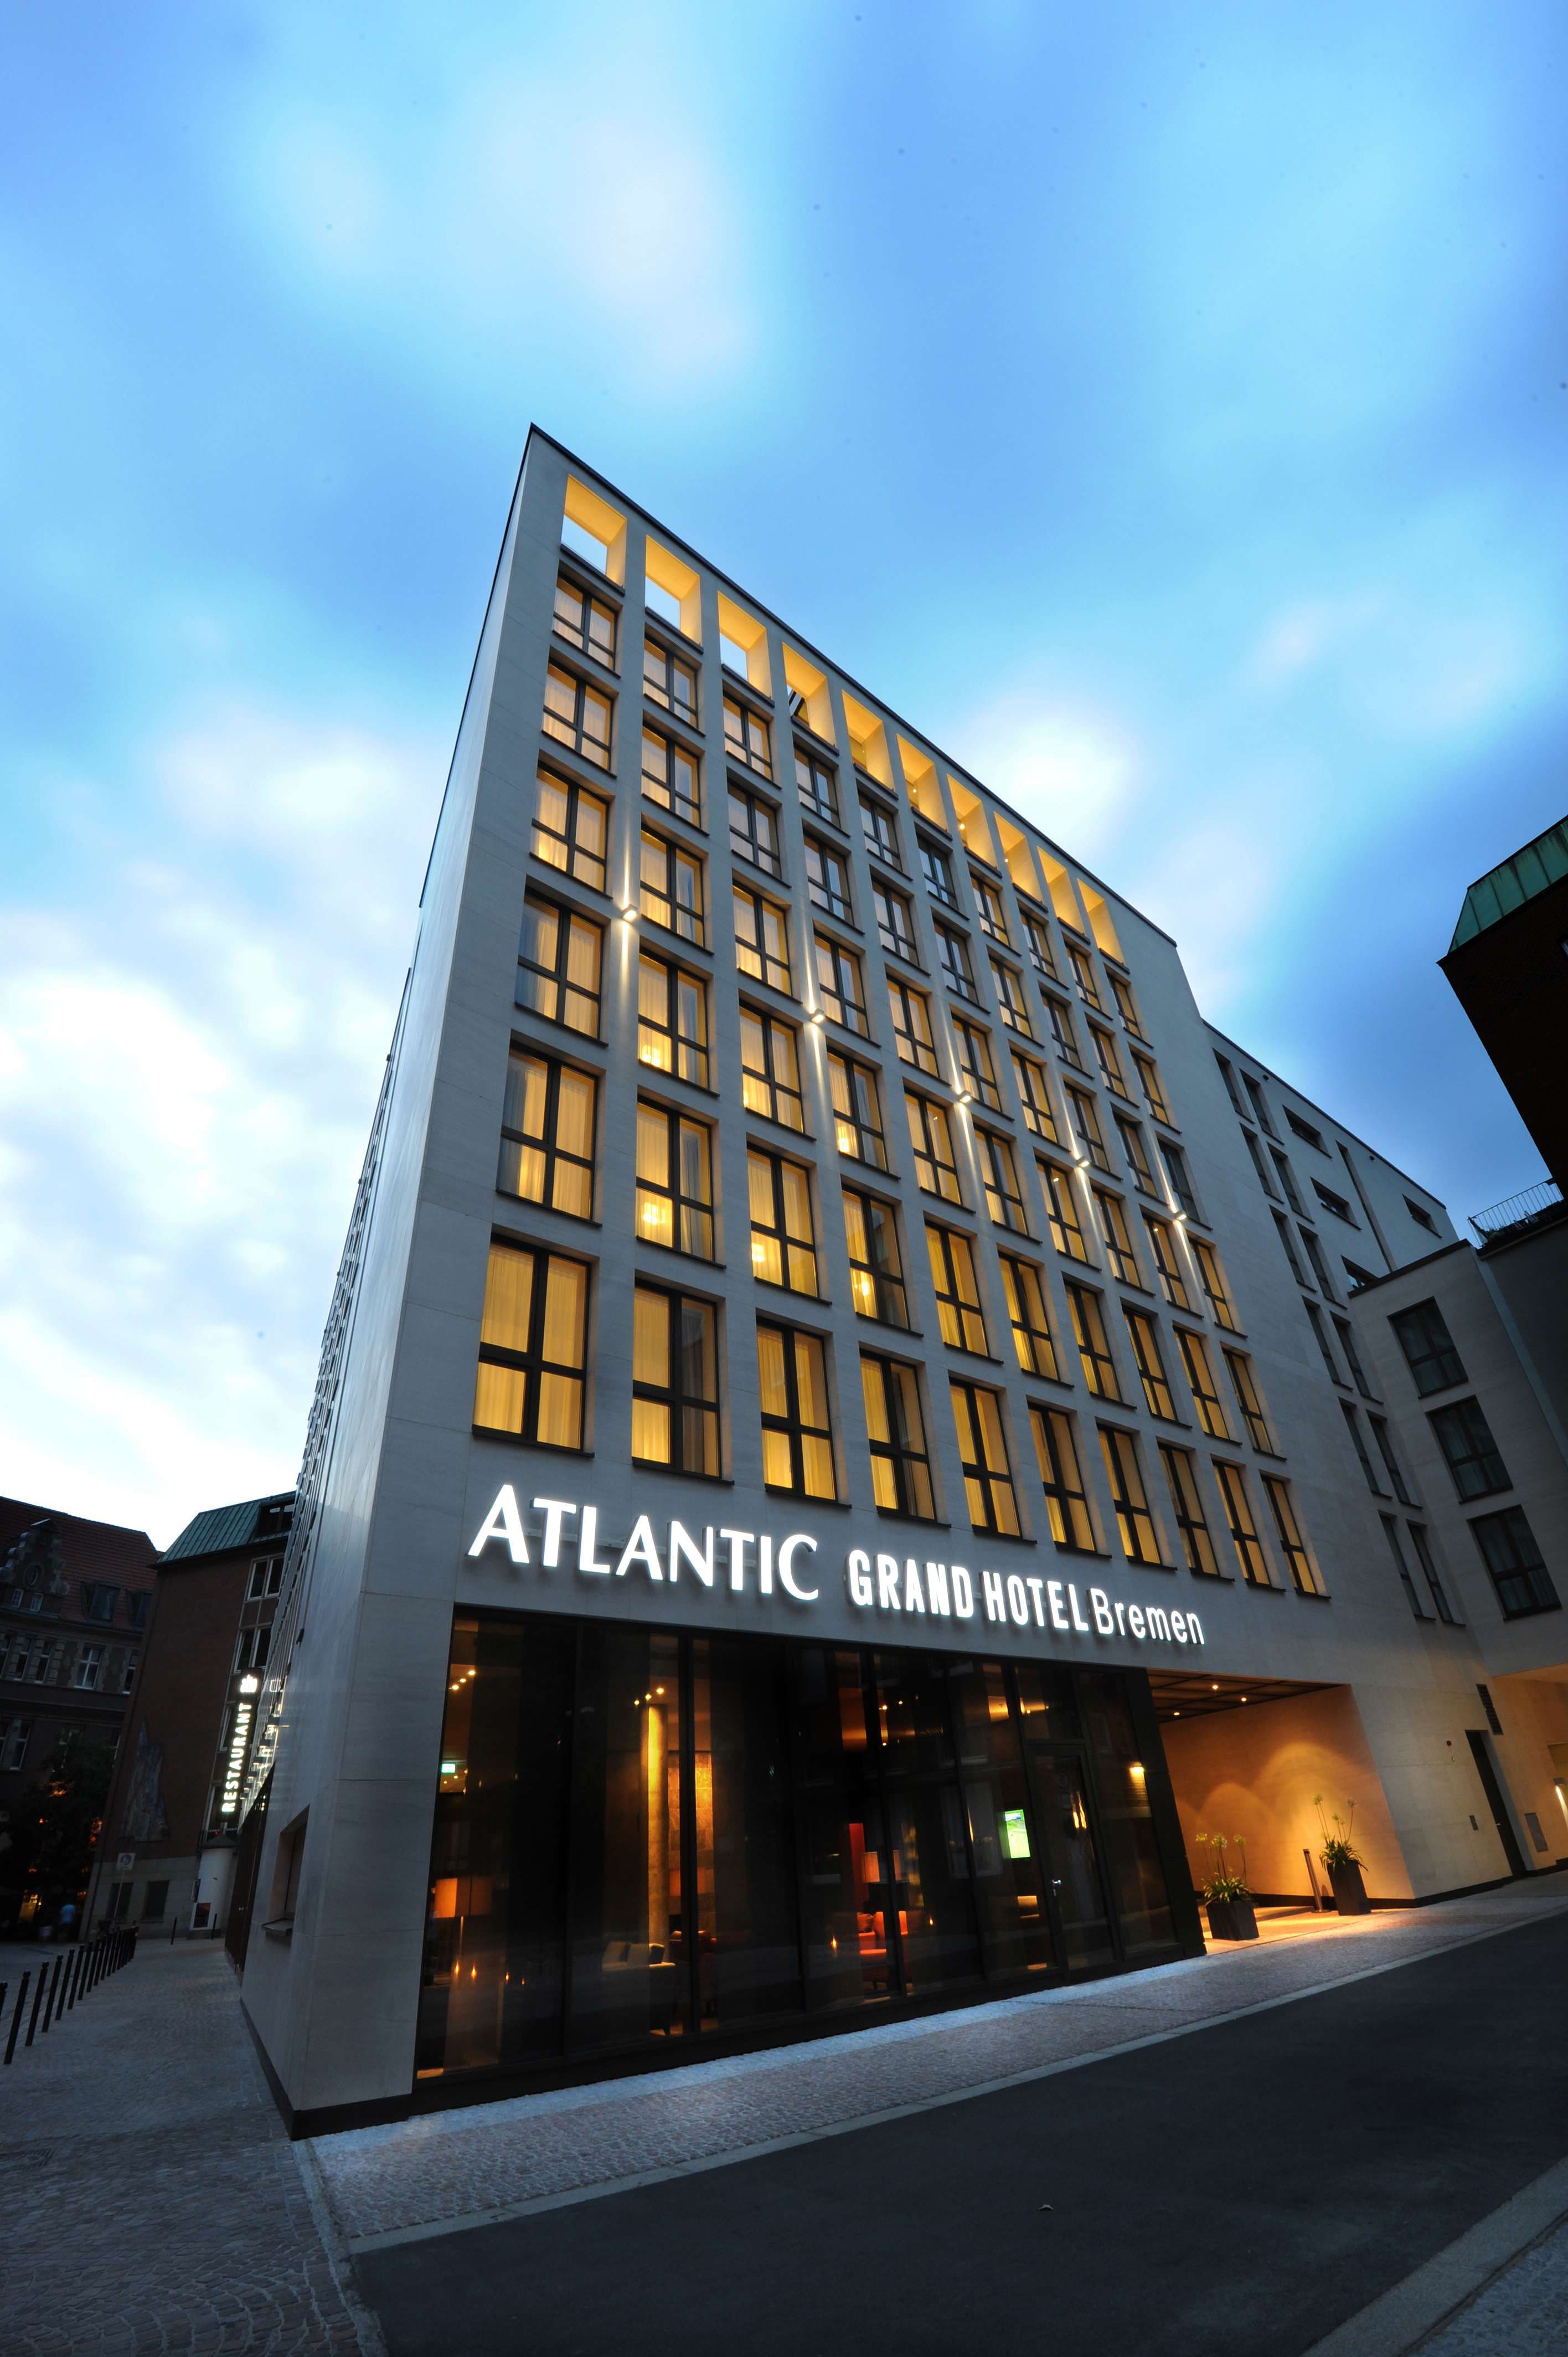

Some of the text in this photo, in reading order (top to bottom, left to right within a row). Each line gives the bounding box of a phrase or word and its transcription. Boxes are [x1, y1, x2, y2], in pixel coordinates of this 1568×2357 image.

[467, 1484, 1206, 1645] ATLANTIC GRAND HOTEL Bremen
[221, 1702, 252, 1813] RESTAURANT
